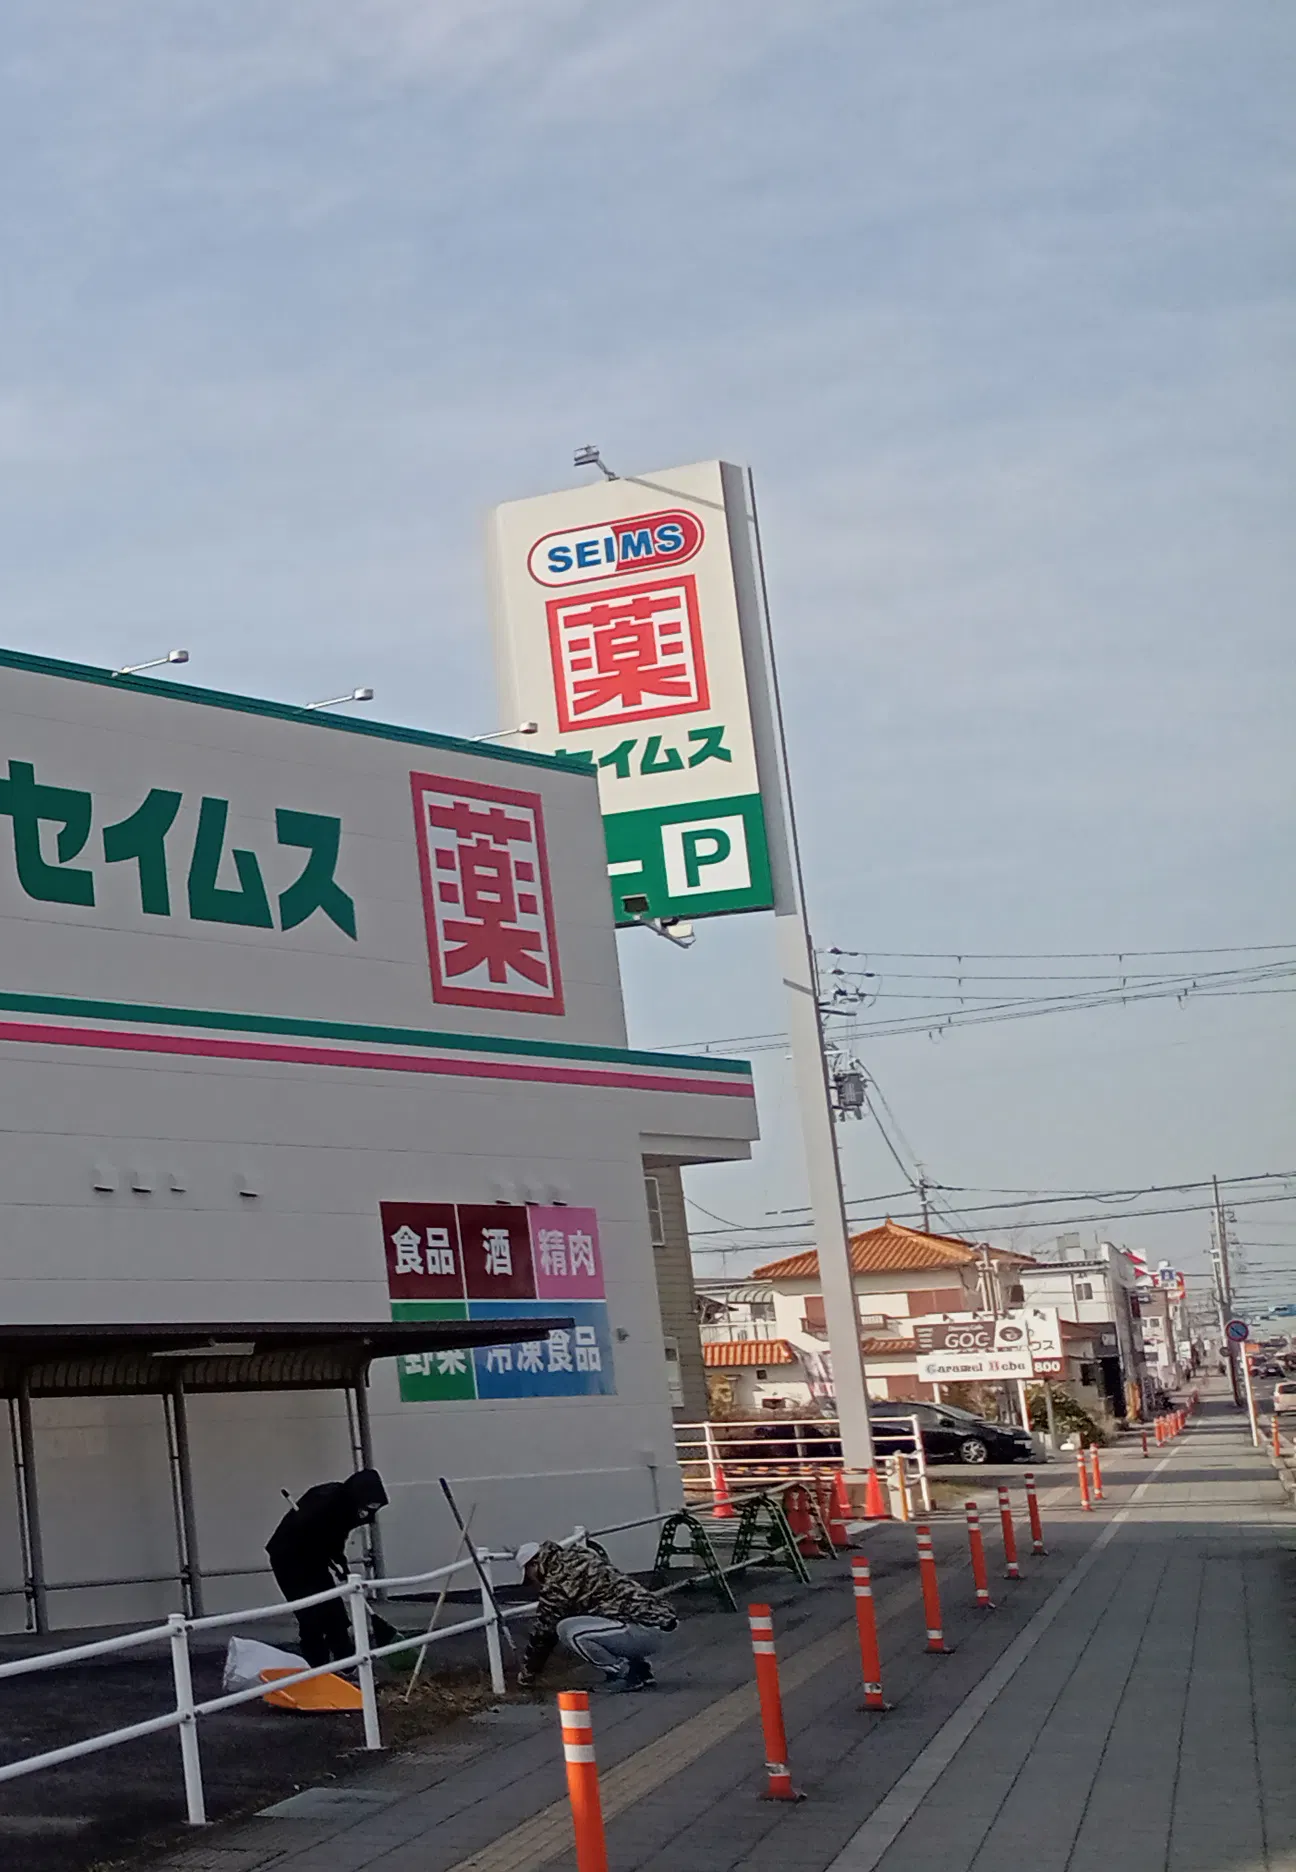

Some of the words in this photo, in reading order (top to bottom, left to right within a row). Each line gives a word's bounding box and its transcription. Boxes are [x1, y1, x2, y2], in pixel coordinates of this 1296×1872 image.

[547, 523, 684, 574] SEIMS
[563, 596, 692, 715] 薬
[681, 827, 732, 889] P
[427, 800, 549, 990] 薬
[390, 1225, 456, 1275] 食品
[482, 1227, 513, 1276] 酒
[537, 1228, 596, 1277] 精肉
